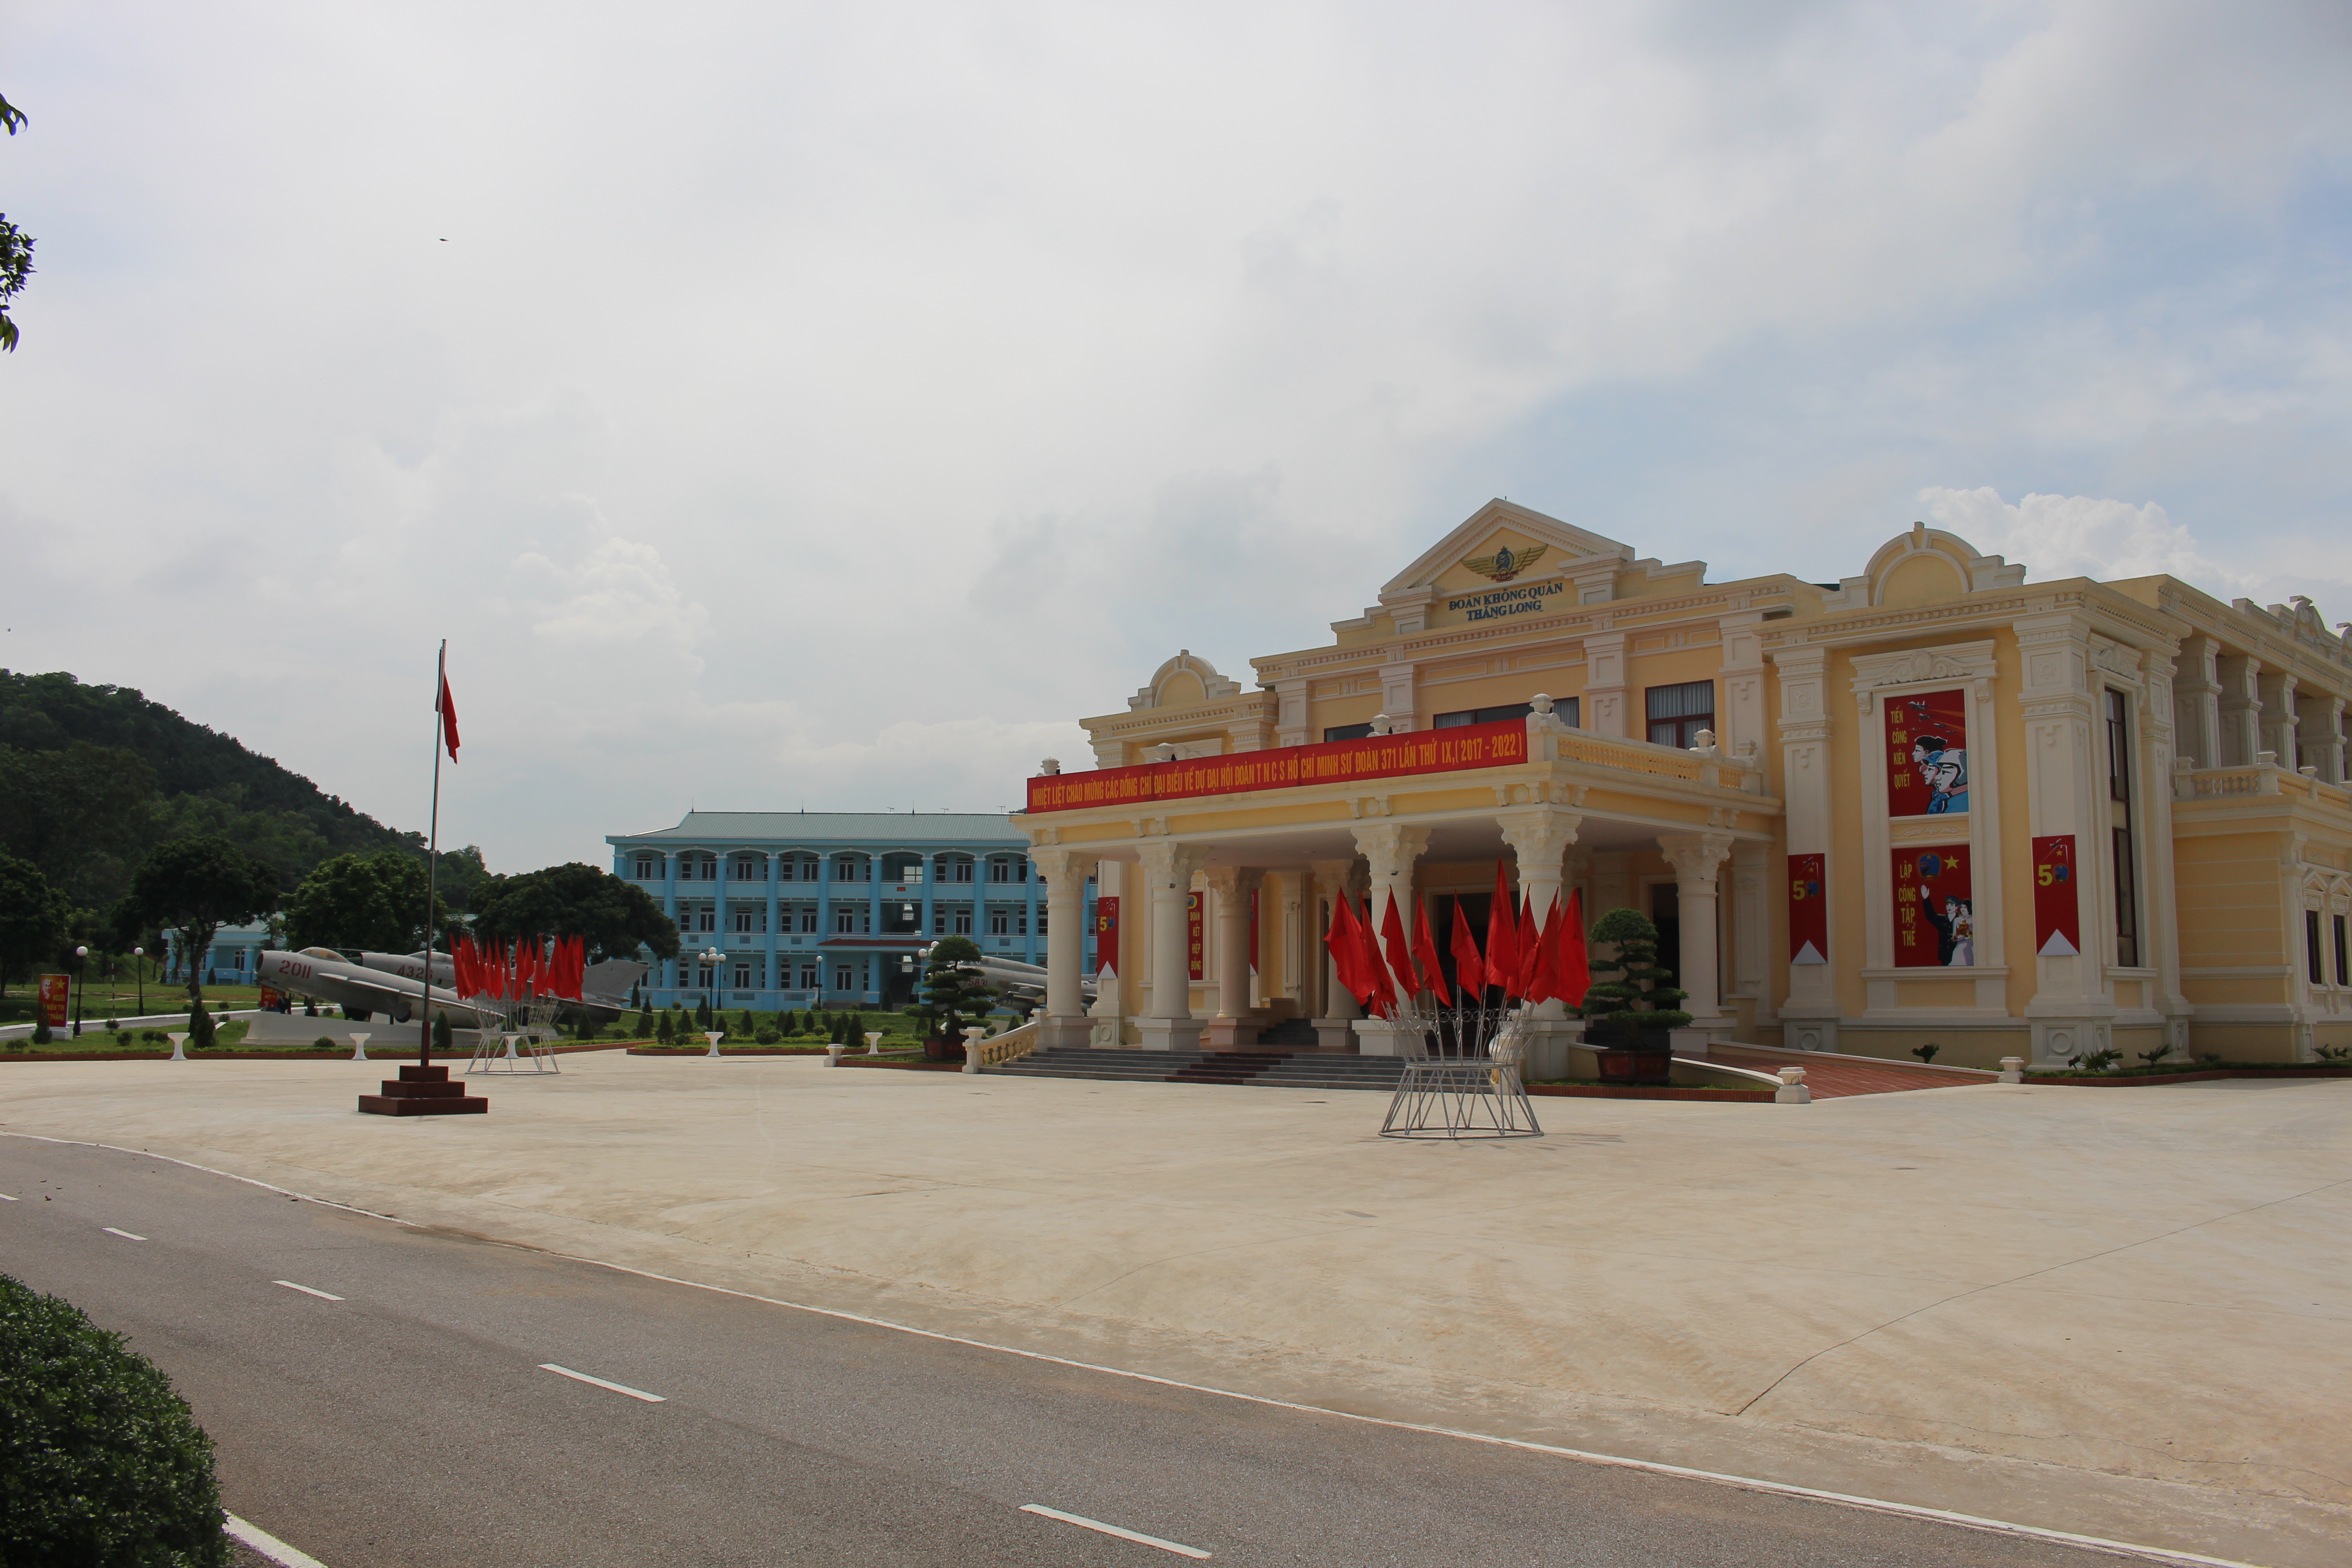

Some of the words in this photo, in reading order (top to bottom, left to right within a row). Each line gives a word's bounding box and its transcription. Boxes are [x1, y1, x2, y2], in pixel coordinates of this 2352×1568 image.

[1449, 596, 1481, 611] ĐOÀN
[1484, 588, 1526, 605] KHÔNG
[1528, 581, 1563, 598] QUÂN
[1467, 606, 1507, 621] THĂNG
[1509, 600, 1542, 614] LONG
[1891, 706, 1903, 724] TIẾN
[1892, 727, 1907, 744] CÔNG
[1894, 749, 1906, 765] KIÊN
[1033, 784, 1050, 808] NHIỆT
[1052, 783, 1065, 808] LIỆT
[1067, 780, 1083, 803] CHÀO
[1084, 779, 1104, 801] MỪNG
[1105, 776, 1118, 799] CÁC
[1120, 773, 1137, 797] ĐỒNG
[1140, 772, 1152, 795] CHÍ
[1154, 774, 1165, 797] ĐẠI
[1167, 766, 1182, 793] BIỂU
[1185, 766, 1194, 791] VỀ
[1196, 768, 1205, 793] DỰ
[1207, 768, 1219, 791] ĐẠI
[1221, 763, 1233, 790] HỘI
[1235, 761, 1254, 785] ĐOÀN
[1288, 753, 1298, 780] HỒ
[1301, 753, 1314, 779] CHÍ
[1317, 755, 1338, 777] MINH
[1341, 750, 1352, 774] SƯ
[1355, 747, 1378, 773] ĐOÀN
[1382, 748, 1396, 770] 371
[1399, 740, 1416, 768] LẦN
[1419, 738, 1437, 766] THỨ
[1894, 769, 1910, 790] QUYẾT
[1900, 860, 1912, 881] LẬP
[1899, 884, 1916, 902] CÔNG
[1901, 903, 1915, 926] TẬP
[1902, 921, 1916, 946] THỂ
[279, 960, 312, 979] 2011
